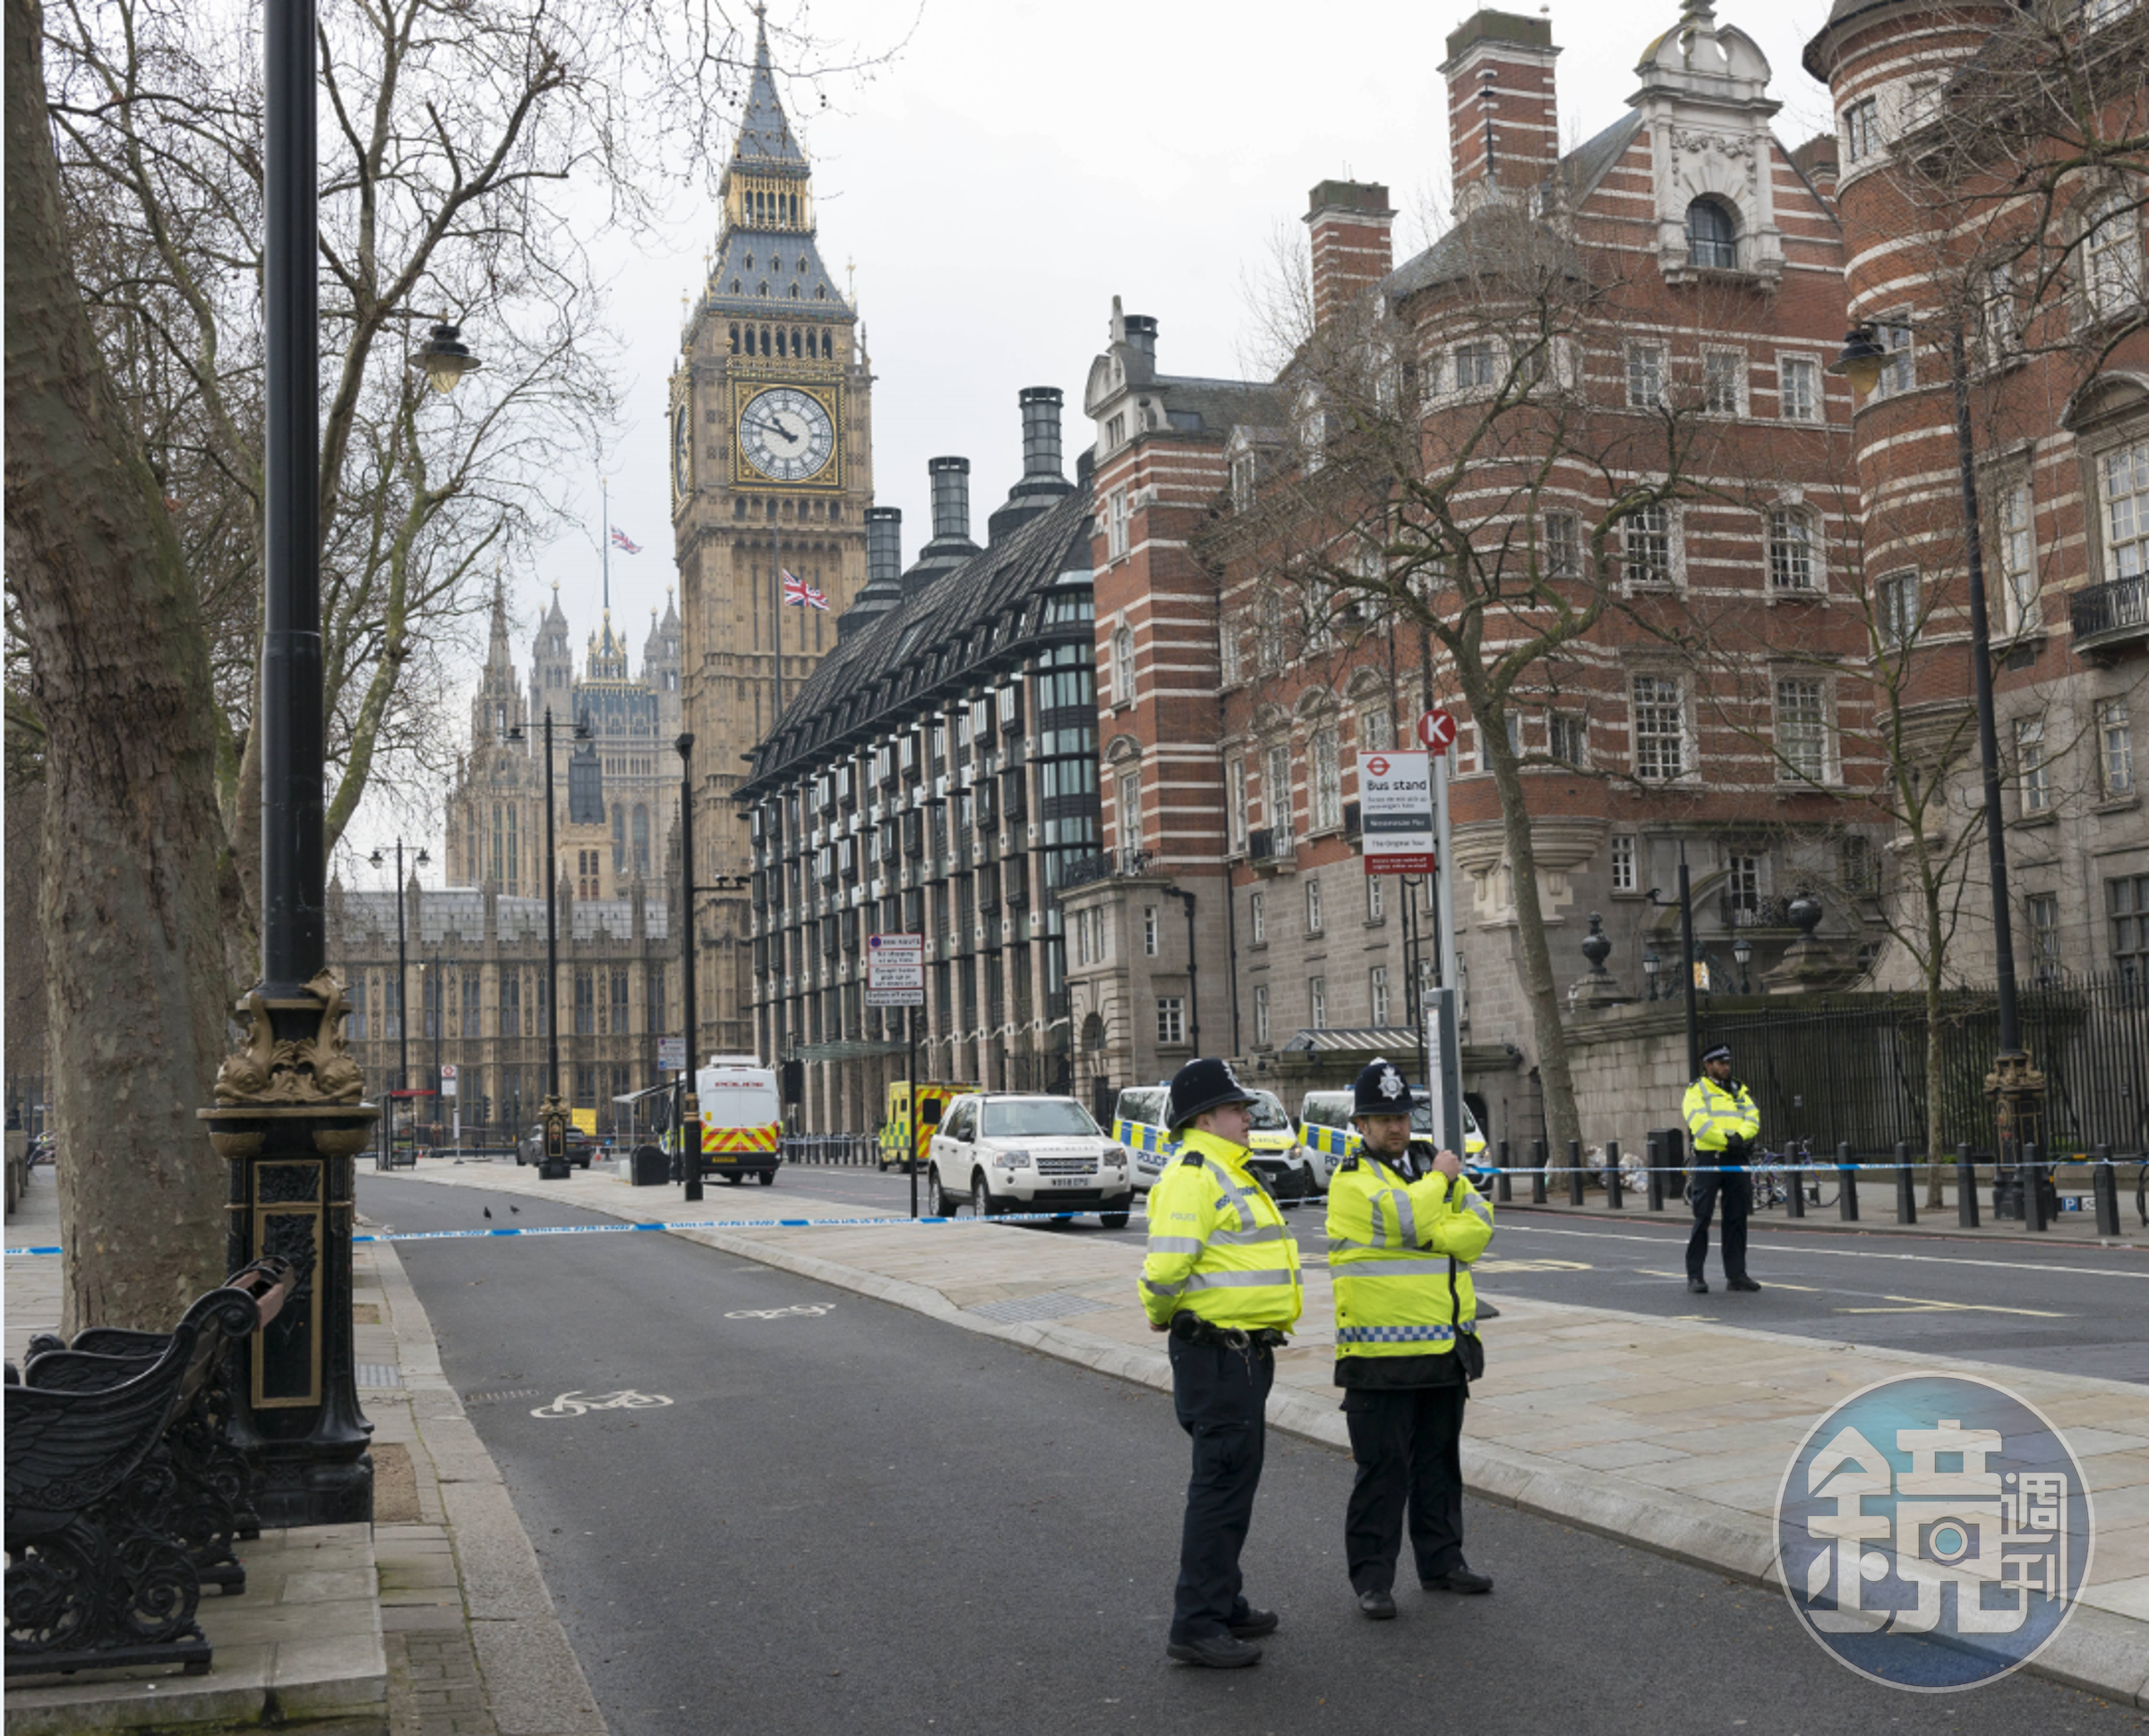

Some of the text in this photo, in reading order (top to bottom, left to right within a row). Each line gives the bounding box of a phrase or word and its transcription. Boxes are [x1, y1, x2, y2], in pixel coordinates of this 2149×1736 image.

[1427, 715, 1449, 743] K
[1366, 780, 1426, 791] Bus stand
[1136, 1150, 1168, 1167] POLICE
[2065, 1198, 2076, 1211] P
[1170, 1211, 1197, 1222] POLICE
